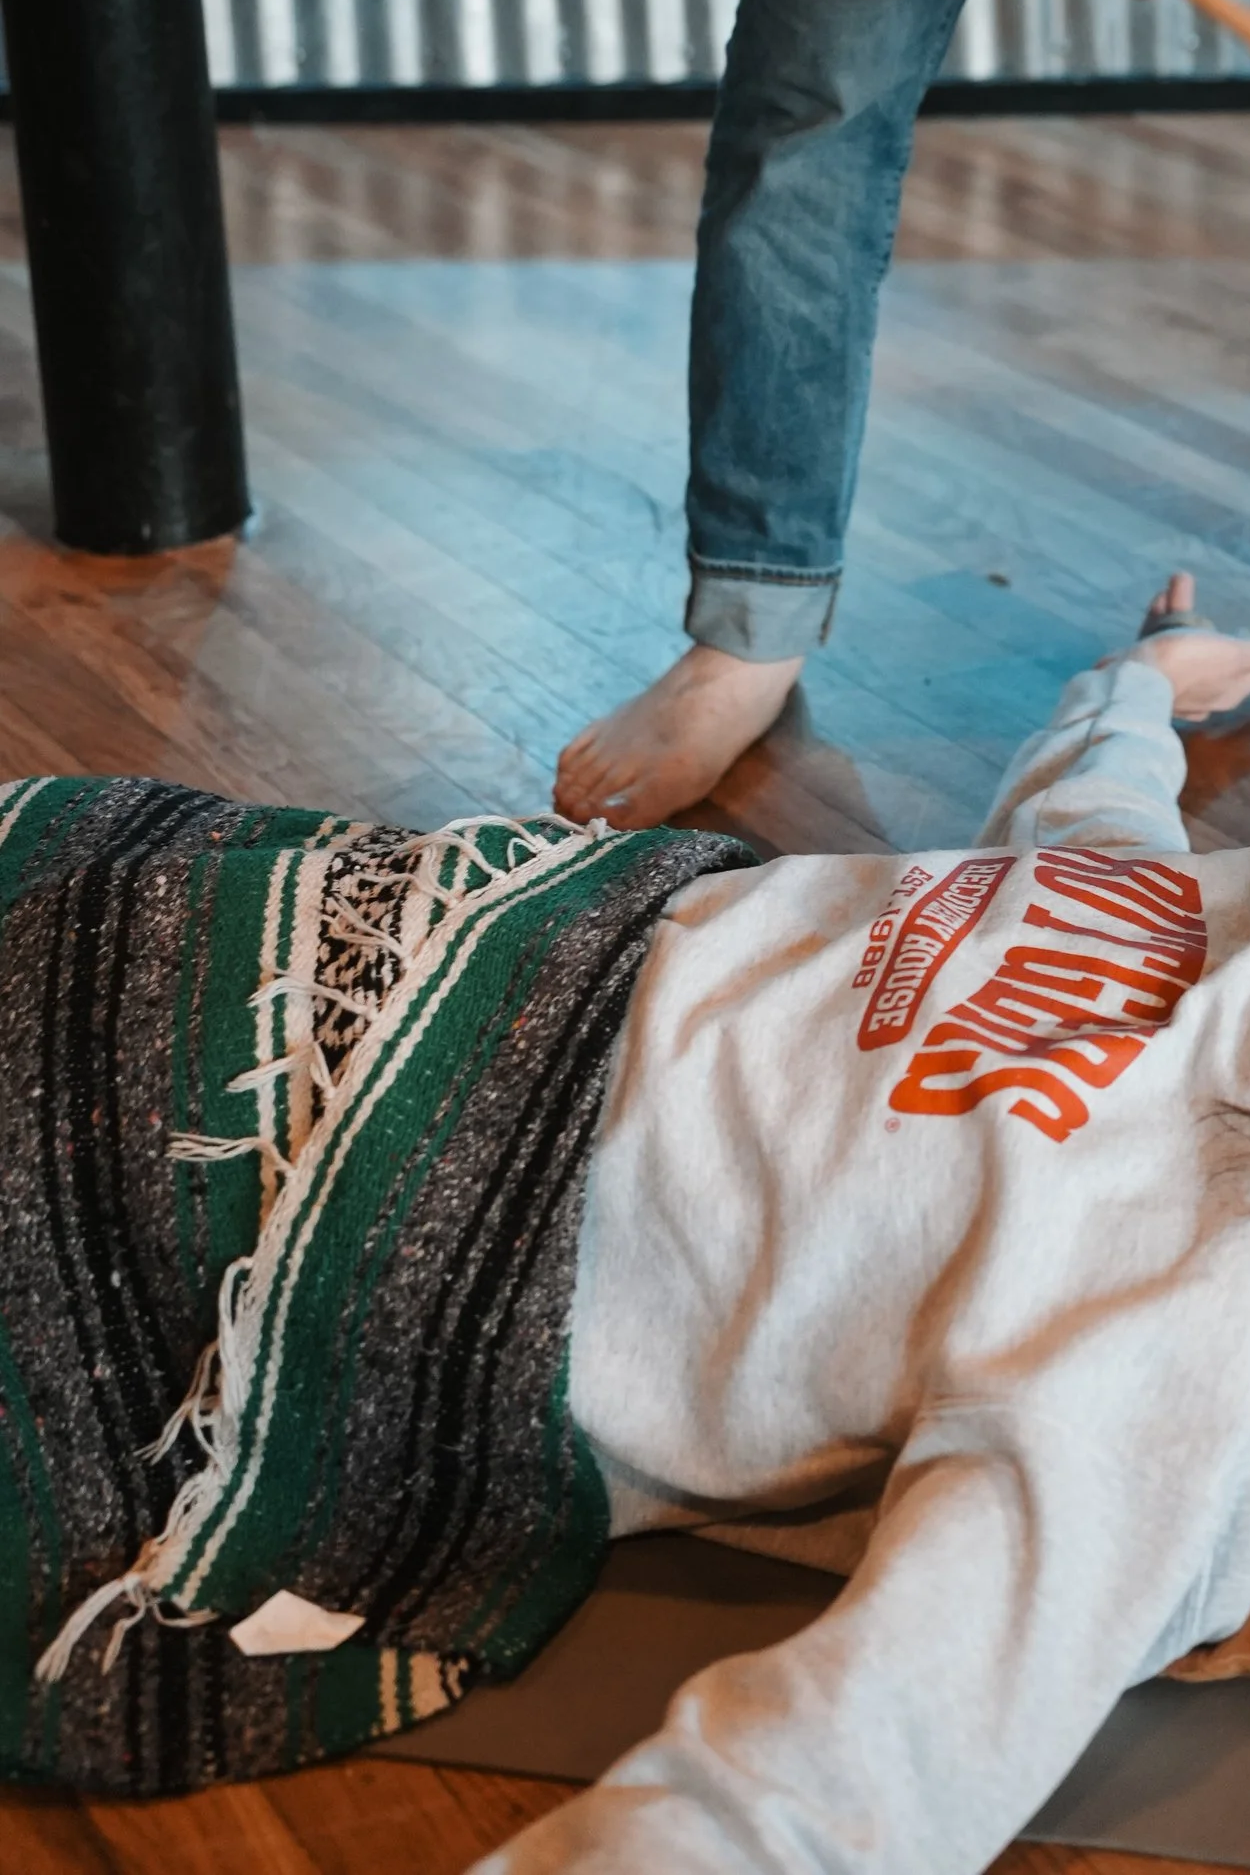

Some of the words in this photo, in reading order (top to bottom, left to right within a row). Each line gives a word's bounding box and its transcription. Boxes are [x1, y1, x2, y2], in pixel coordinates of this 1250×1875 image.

[915, 863, 1006, 942] RECOVERY
[852, 907, 903, 989] 1988
[867, 933, 945, 1032] HOUSE
[889, 845, 1208, 1143] RUTGERS
